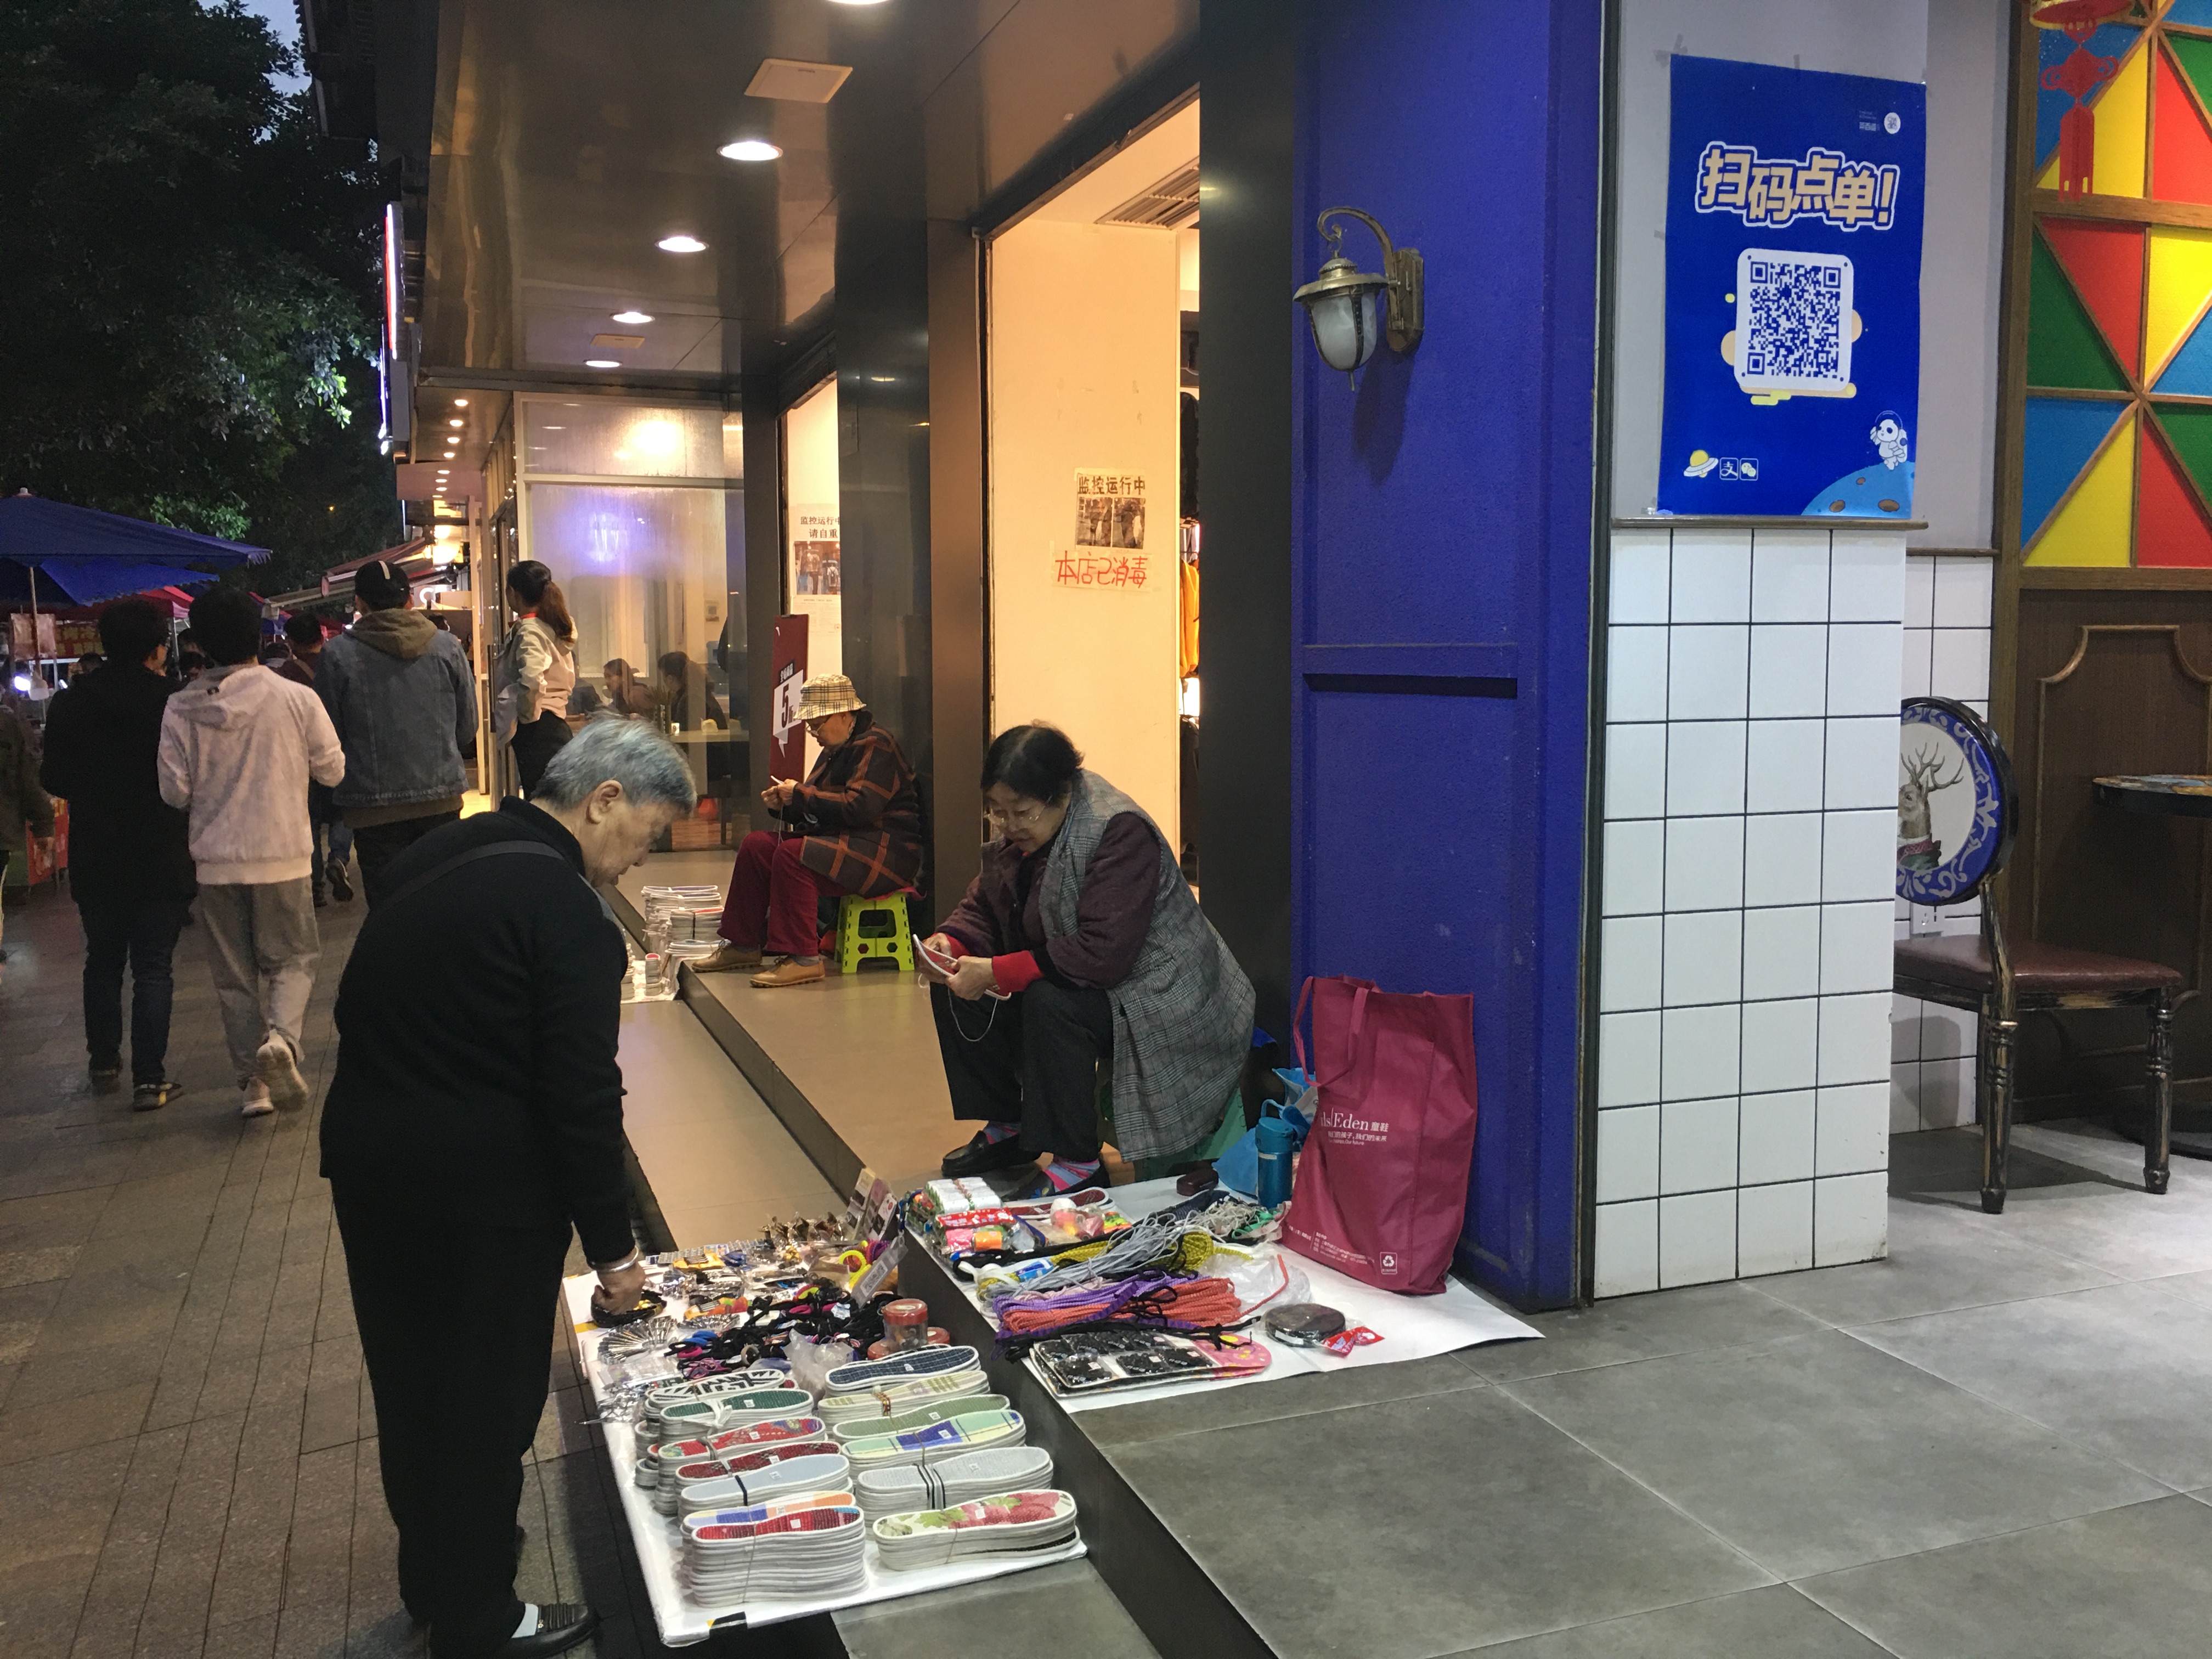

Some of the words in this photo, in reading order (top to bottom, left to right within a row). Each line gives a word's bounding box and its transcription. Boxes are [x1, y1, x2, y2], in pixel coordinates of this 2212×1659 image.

[1077, 476, 1146, 495] 监控运行中
[809, 528, 838, 539] 请自重
[1055, 550, 1148, 589] 本店已消毒
[1333, 1112, 1369, 1131] Eden
